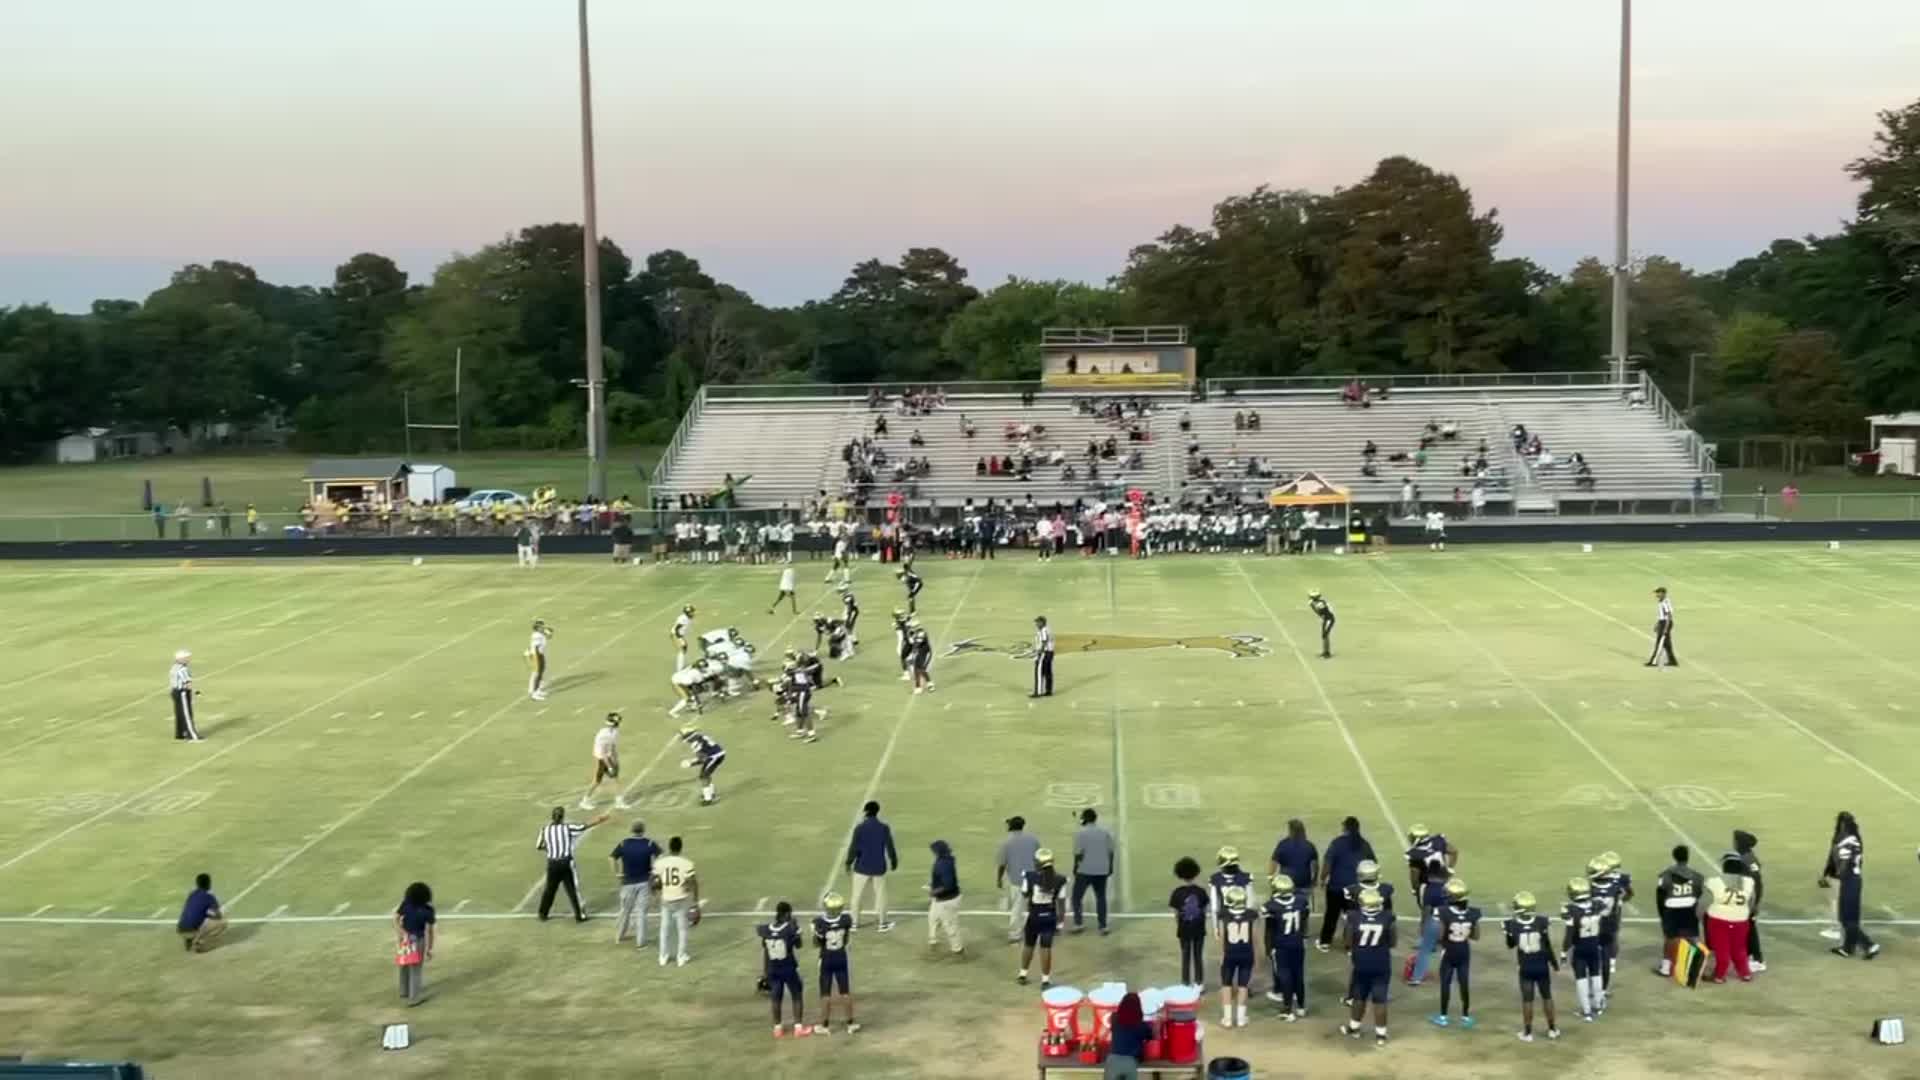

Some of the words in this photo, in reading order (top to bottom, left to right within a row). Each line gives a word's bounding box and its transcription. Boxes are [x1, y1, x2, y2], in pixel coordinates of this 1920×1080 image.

[665, 867, 681, 886] 16
[1724, 888, 1746, 906] 75
[1282, 910, 1301, 936] 71
[1358, 924, 1383, 946] 77
[1053, 1012, 1069, 1029] G
